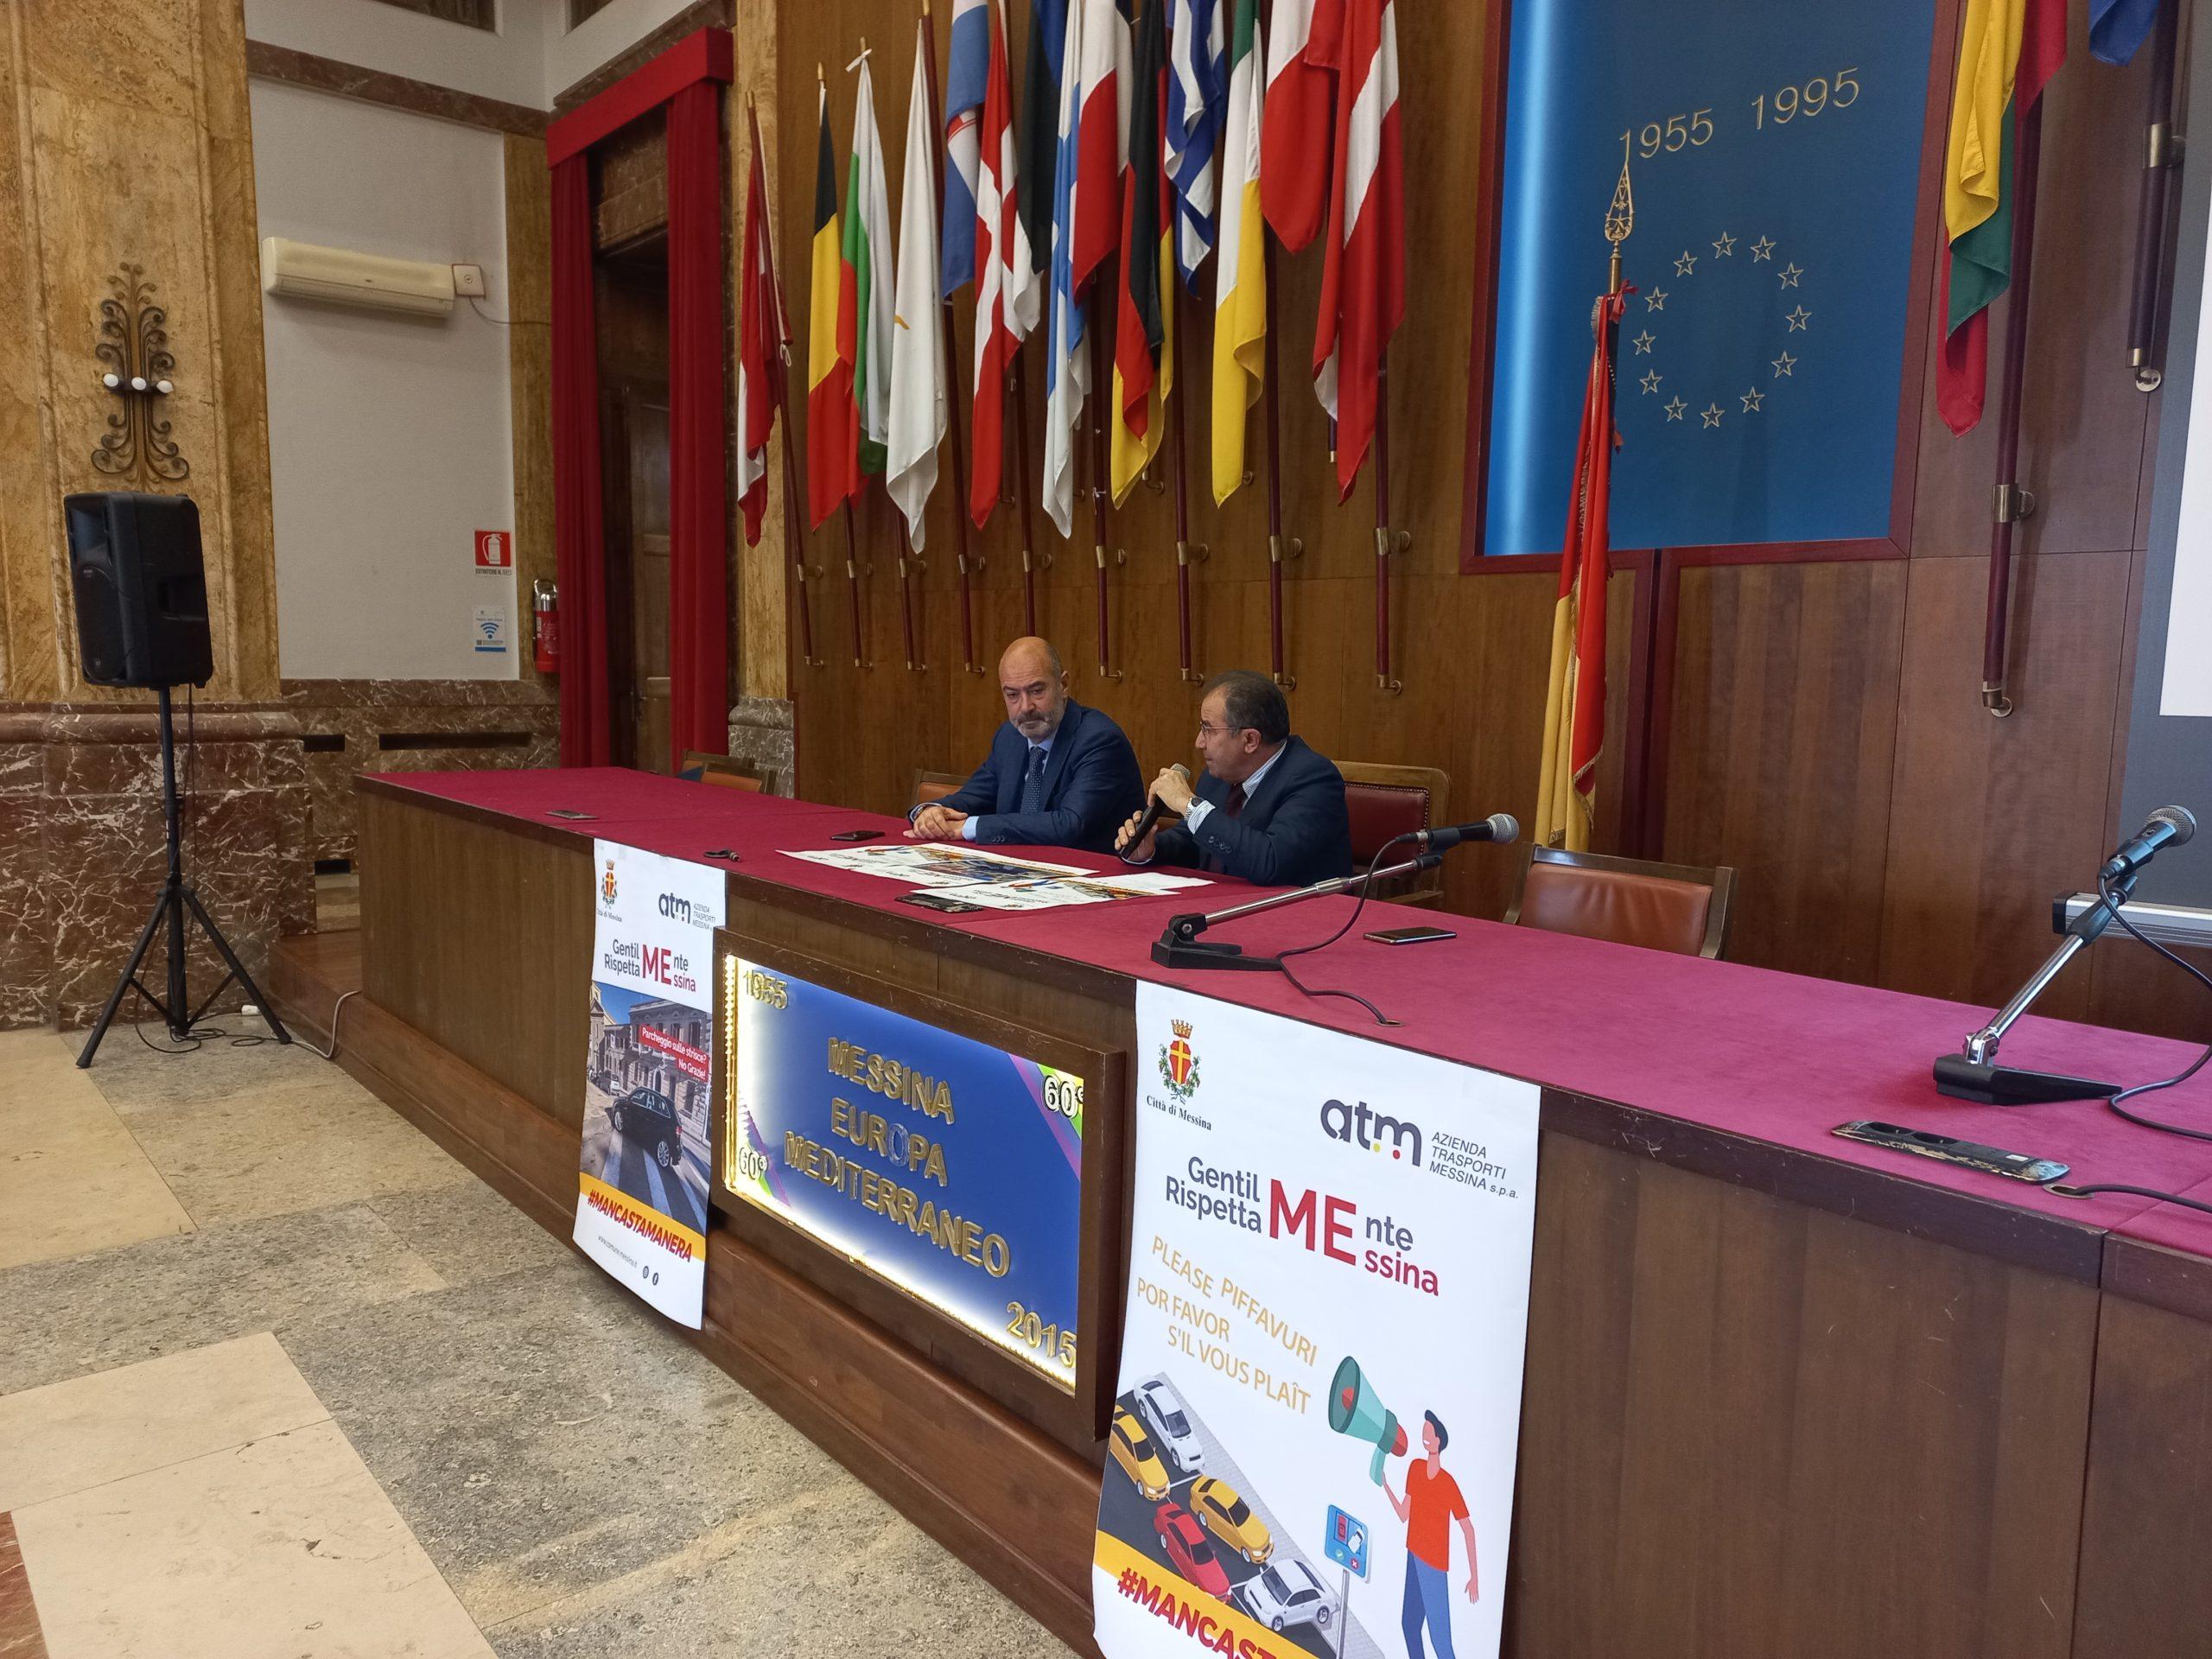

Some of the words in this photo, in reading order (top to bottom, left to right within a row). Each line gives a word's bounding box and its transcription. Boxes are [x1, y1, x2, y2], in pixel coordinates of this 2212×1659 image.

[1619, 107, 1714, 163] 1955
[1751, 67, 1860, 130] 1995
[658, 893, 691, 924] atm
[604, 953, 640, 977] Rispetta
[613, 938, 639, 960] Gentil
[642, 944, 671, 986] ME
[673, 955, 689, 971] nte
[673, 973, 696, 992] ssina
[743, 969, 788, 1010] 1955
[642, 1027, 672, 1049] Parcheggio
[671, 1041, 686, 1055] sulle
[678, 1058, 687, 1071] No
[828, 1037, 956, 1125] MESSINA
[1147, 1095, 1166, 1111] Città
[1168, 1103, 1177, 1116] di
[1179, 1108, 1211, 1130] Messina
[1320, 1098, 1422, 1167] atm
[831, 1096, 948, 1187] EUROPA
[1431, 1131, 1487, 1159] AZIENDA
[1431, 1146, 1507, 1180] TRASPORTI
[1187, 1155, 1261, 1203] Gentil
[1428, 1163, 1487, 1190] MESSINA
[1490, 1182, 1519, 1199] s.p.a.
[587, 1189, 693, 1263] #MANCASTAMANERA
[784, 1130, 1011, 1278] MEDITERRANEO
[1166, 1175, 1262, 1234] Rispetta
[1268, 1179, 1357, 1267] ME
[1366, 1216, 1414, 1251] nte
[1364, 1249, 1440, 1297] ssina
[1137, 1277, 1169, 1313] POR
[1172, 1295, 1230, 1342] FAVOR
[1152, 1235, 1214, 1299] PLEASE
[1221, 1277, 1318, 1367] PIFFAVURI
[1005, 1300, 1077, 1369] 2015
[1167, 1325, 1196, 1357] S'IL
[1198, 1338, 1249, 1385] VOUS
[1254, 1367, 1312, 1414] PLAÎT
